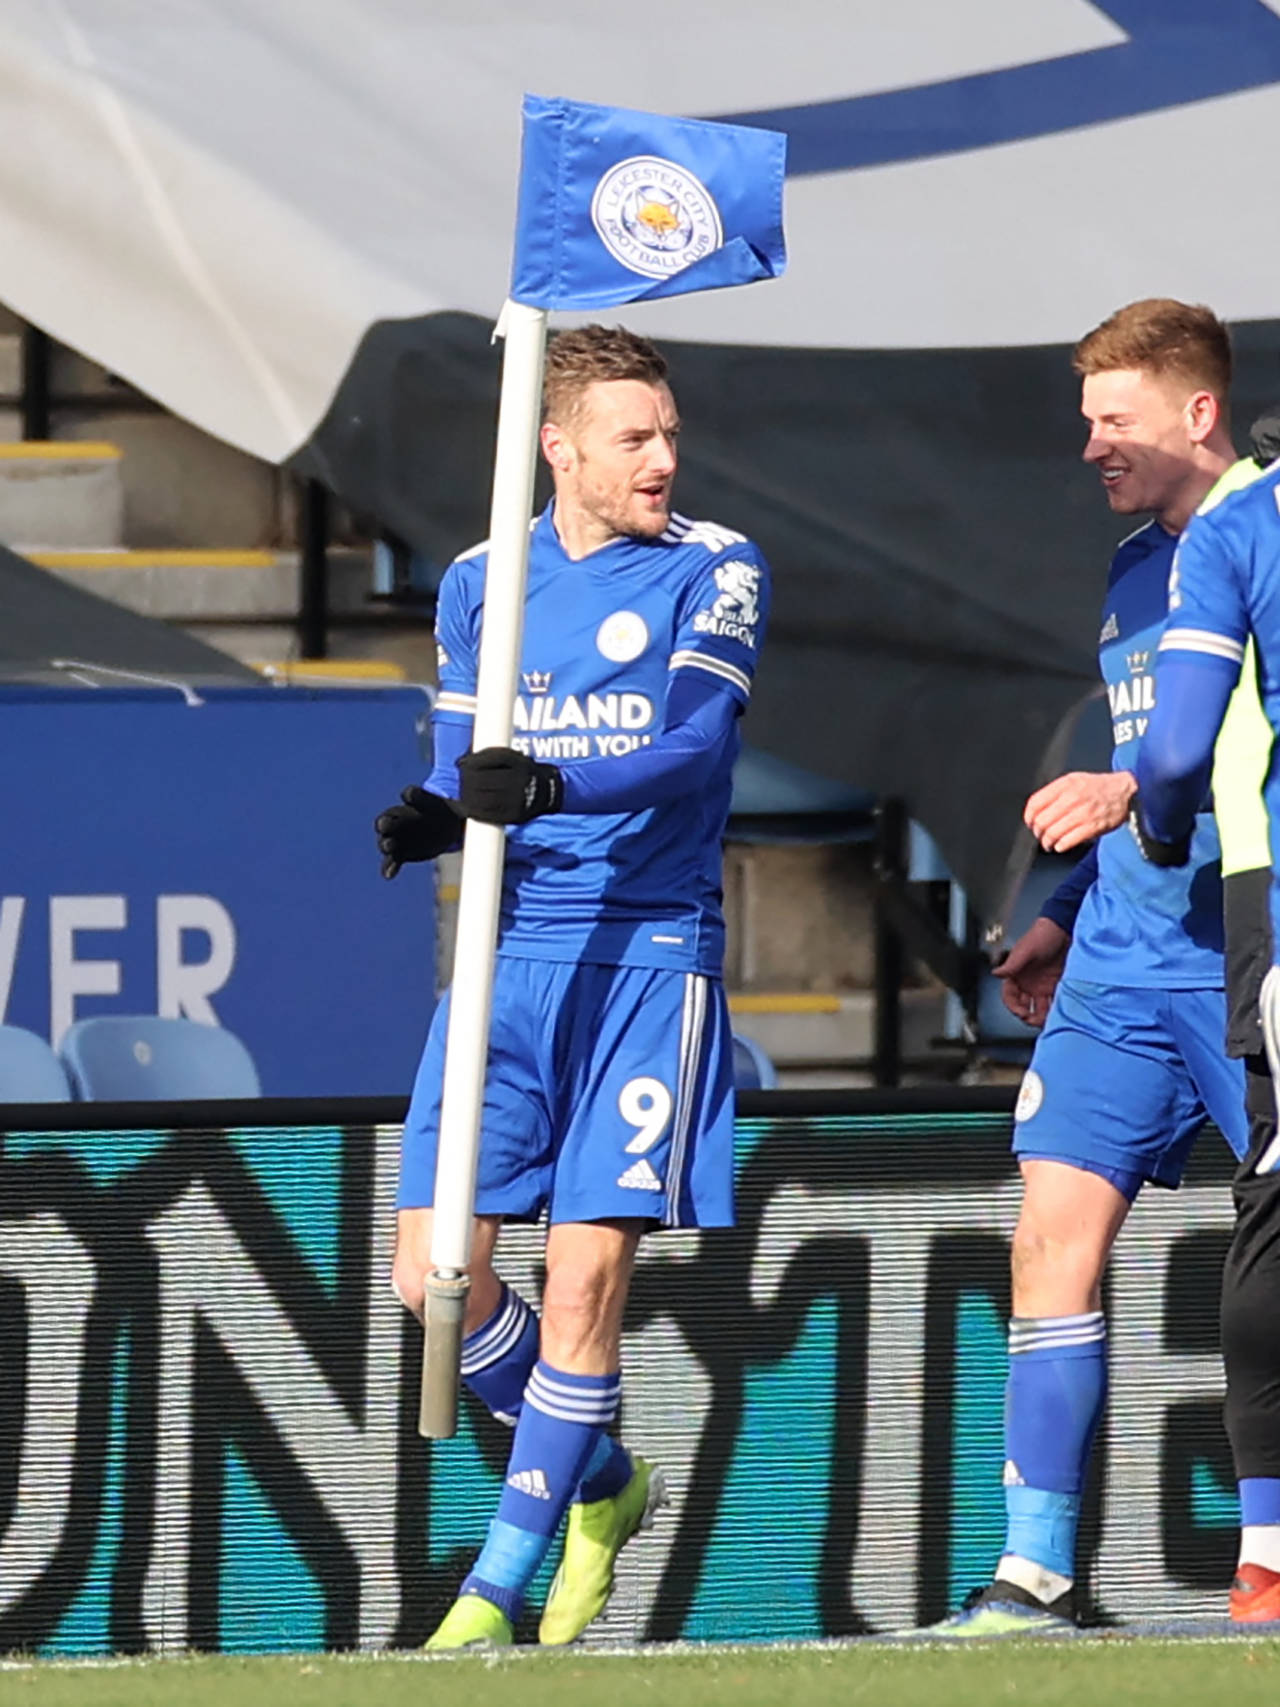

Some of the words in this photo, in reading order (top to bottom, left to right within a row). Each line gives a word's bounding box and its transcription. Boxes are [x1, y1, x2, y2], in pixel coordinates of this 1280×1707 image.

[607, 168, 683, 208] LEICESTER
[684, 191, 709, 227] CITY
[605, 218, 681, 268] FOOTBALL
[513, 693, 653, 732] AILAND
[532, 736, 589, 758] WITH
[618, 1076, 672, 1154] 9
